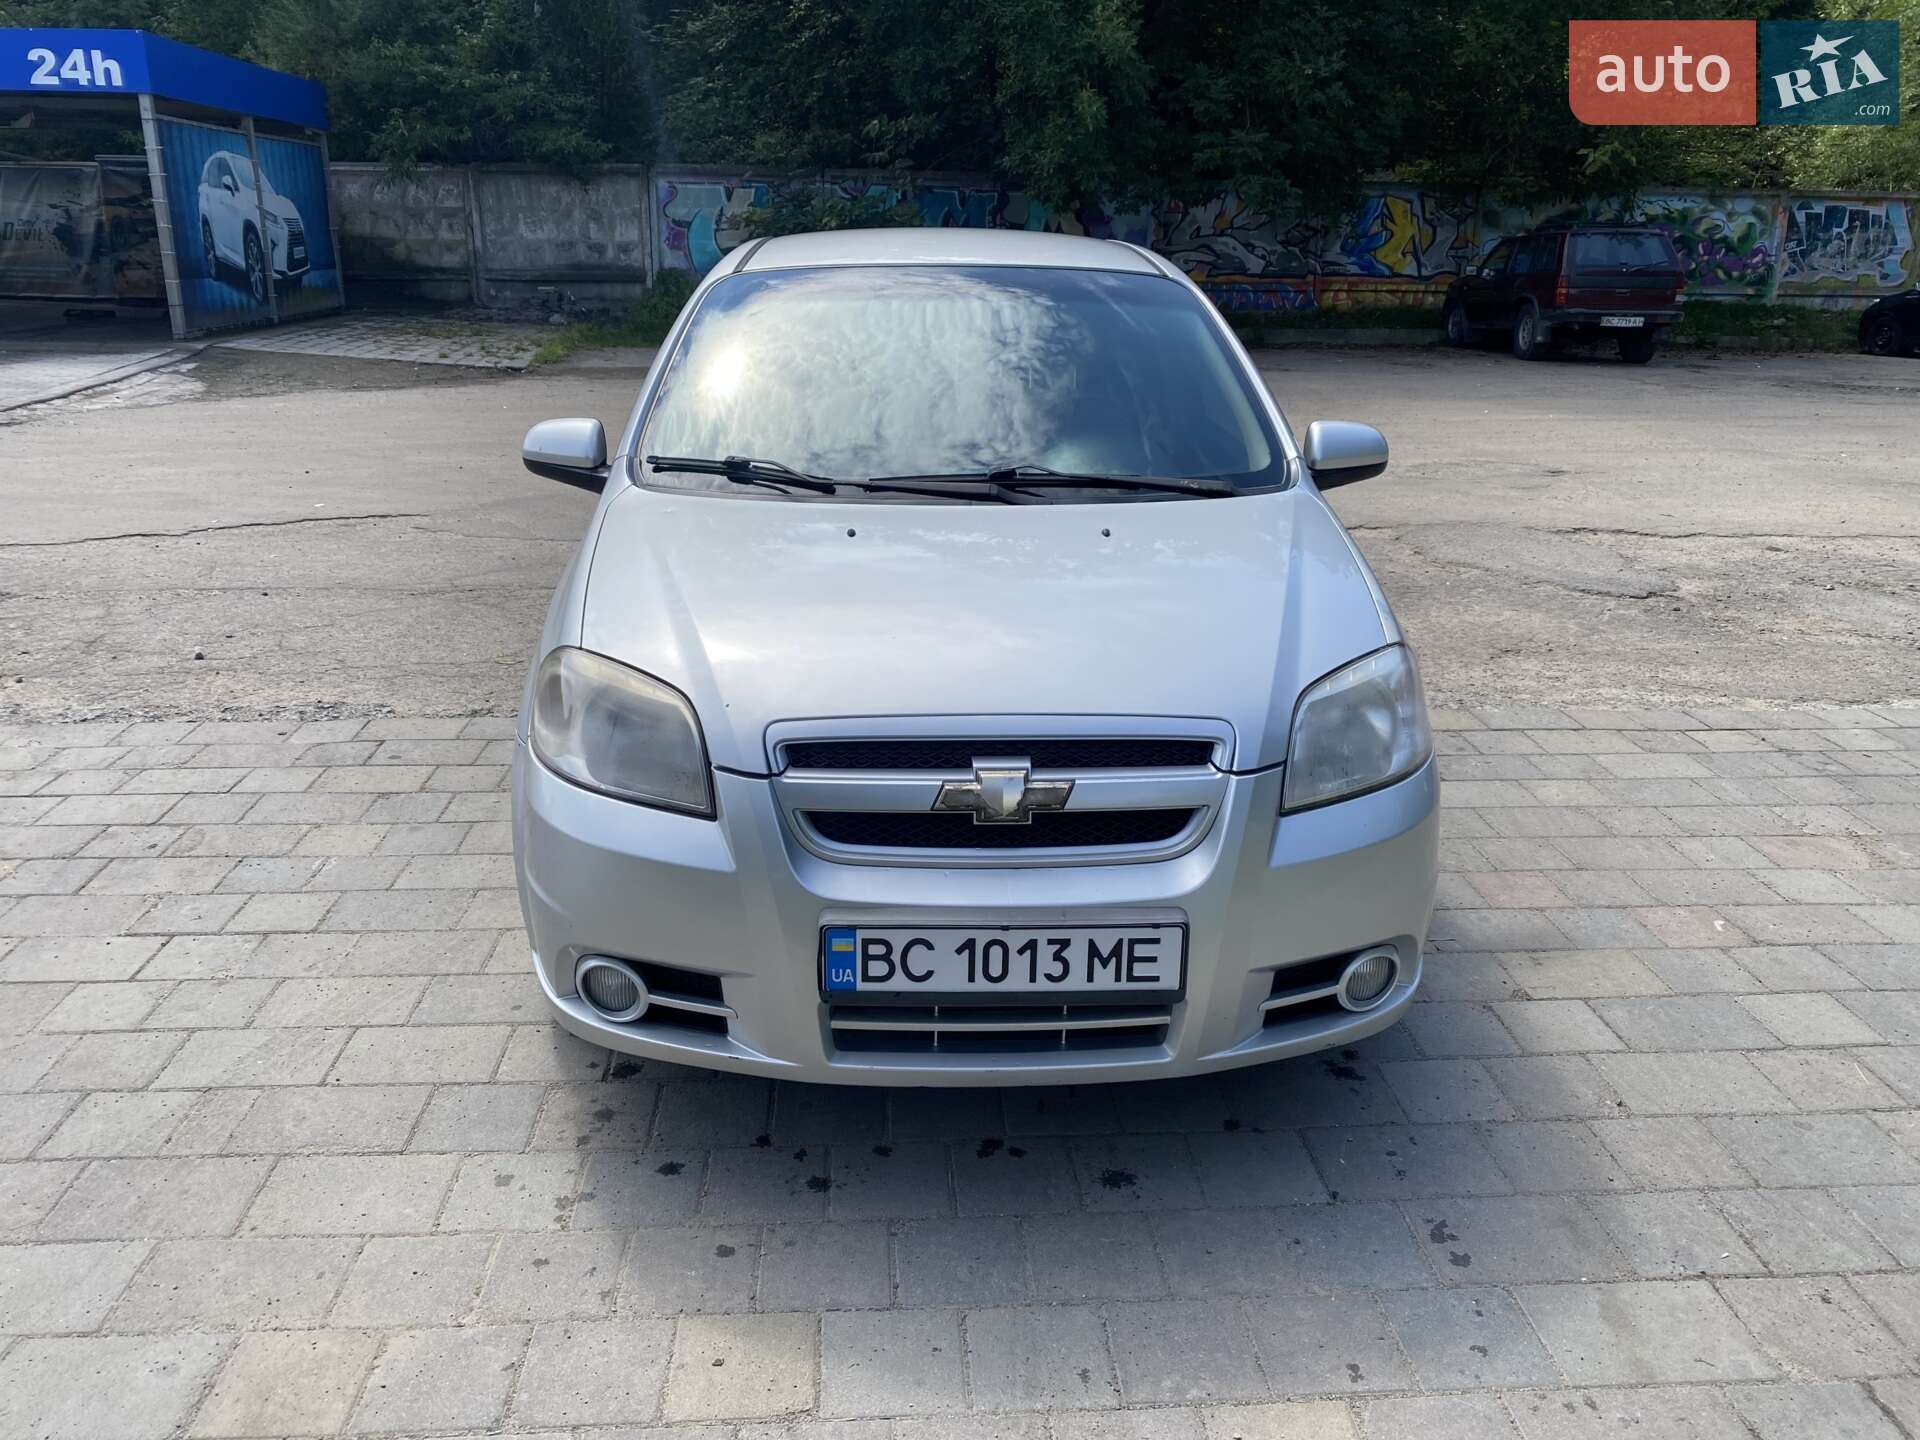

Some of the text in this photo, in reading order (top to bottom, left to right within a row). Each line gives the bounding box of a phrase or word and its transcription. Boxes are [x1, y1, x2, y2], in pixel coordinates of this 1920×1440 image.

[27, 48, 123, 87] 24h
[831, 968, 855, 983] UA
[860, 937, 1161, 983] BC 1013 ME
